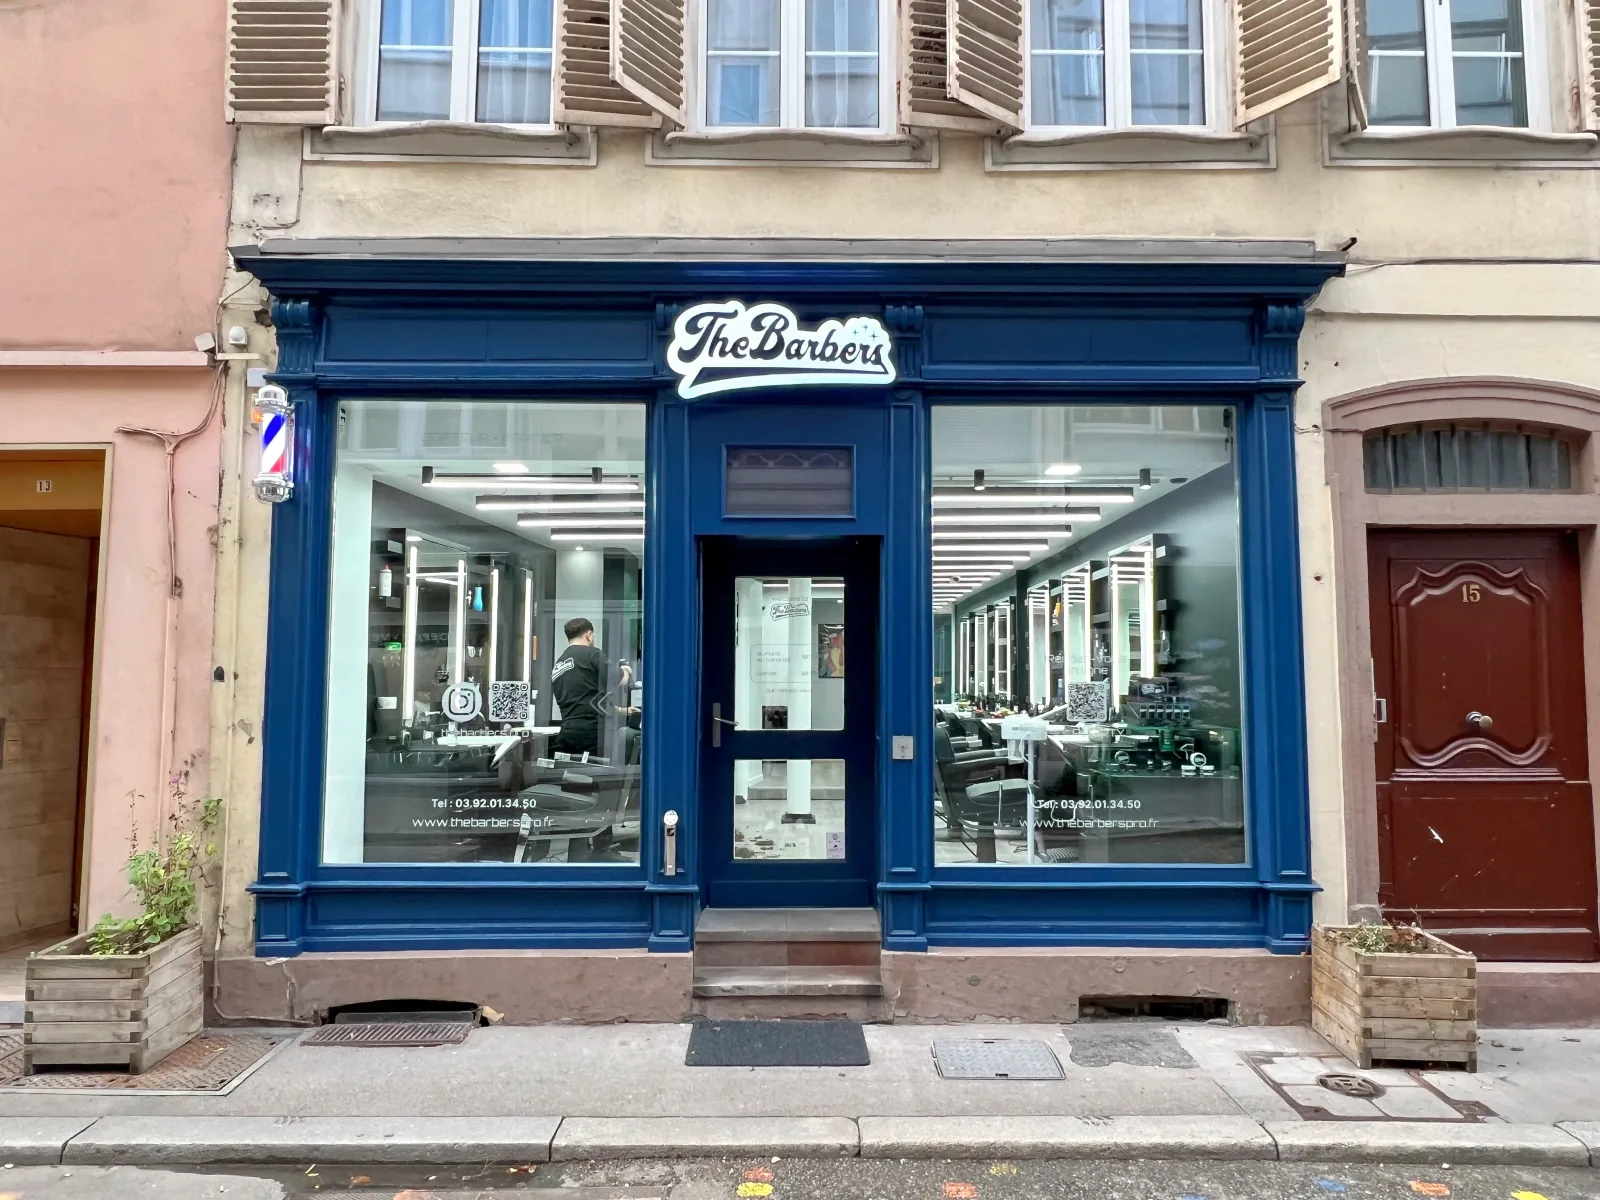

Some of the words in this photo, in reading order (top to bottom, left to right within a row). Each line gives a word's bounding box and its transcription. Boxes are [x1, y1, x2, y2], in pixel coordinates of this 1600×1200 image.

[677, 309, 751, 363] The
[750, 311, 886, 366] Barbers
[39, 480, 51, 491] 13
[1461, 584, 1481, 603] 15
[432, 799, 447, 808] Tel
[455, 798, 537, 809] 03.92.01.34.50
[1060, 799, 1141, 809] 03.92.01.34.50
[412, 816, 554, 829] www.thebarbersro.fr
[1019, 818, 1159, 830] www.thebarberspro.fr
